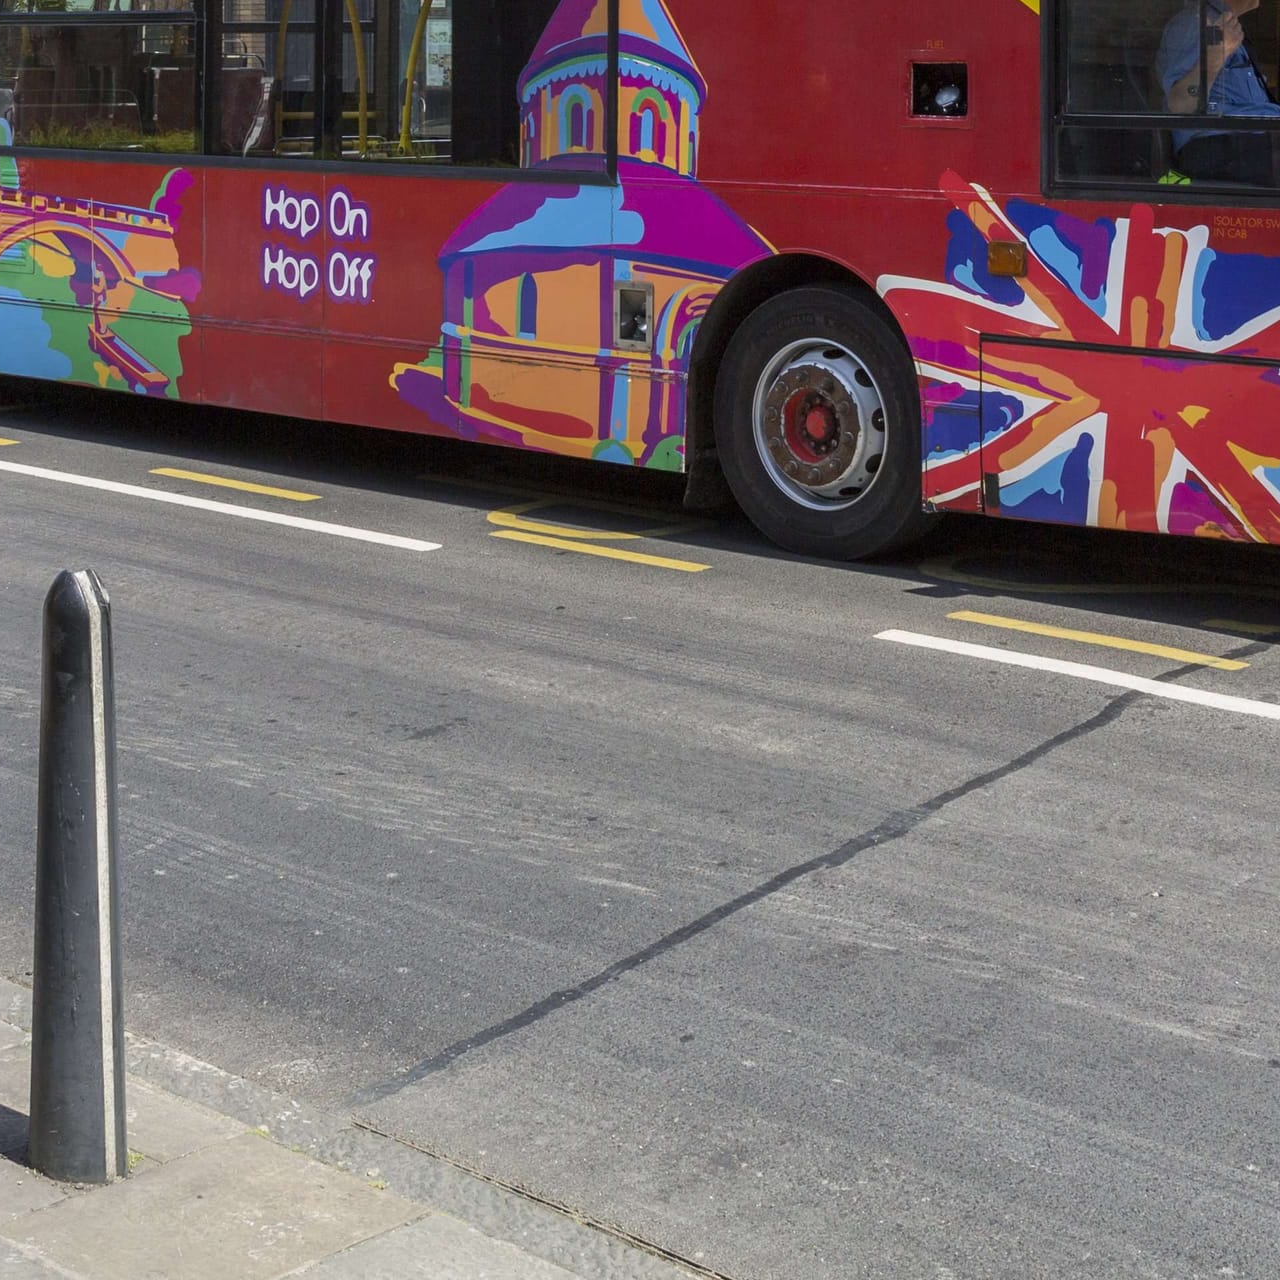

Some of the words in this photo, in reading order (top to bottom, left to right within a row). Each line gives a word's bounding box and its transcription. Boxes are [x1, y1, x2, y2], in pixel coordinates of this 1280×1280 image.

[265, 188, 320, 237] Hop
[329, 191, 368, 237] On
[1213, 215, 1264, 228] ISOLATOR
[1213, 227, 1225, 238] IN
[1227, 228, 1248, 239] CAB
[264, 247, 319, 297] Hop
[328, 252, 374, 298] Off
